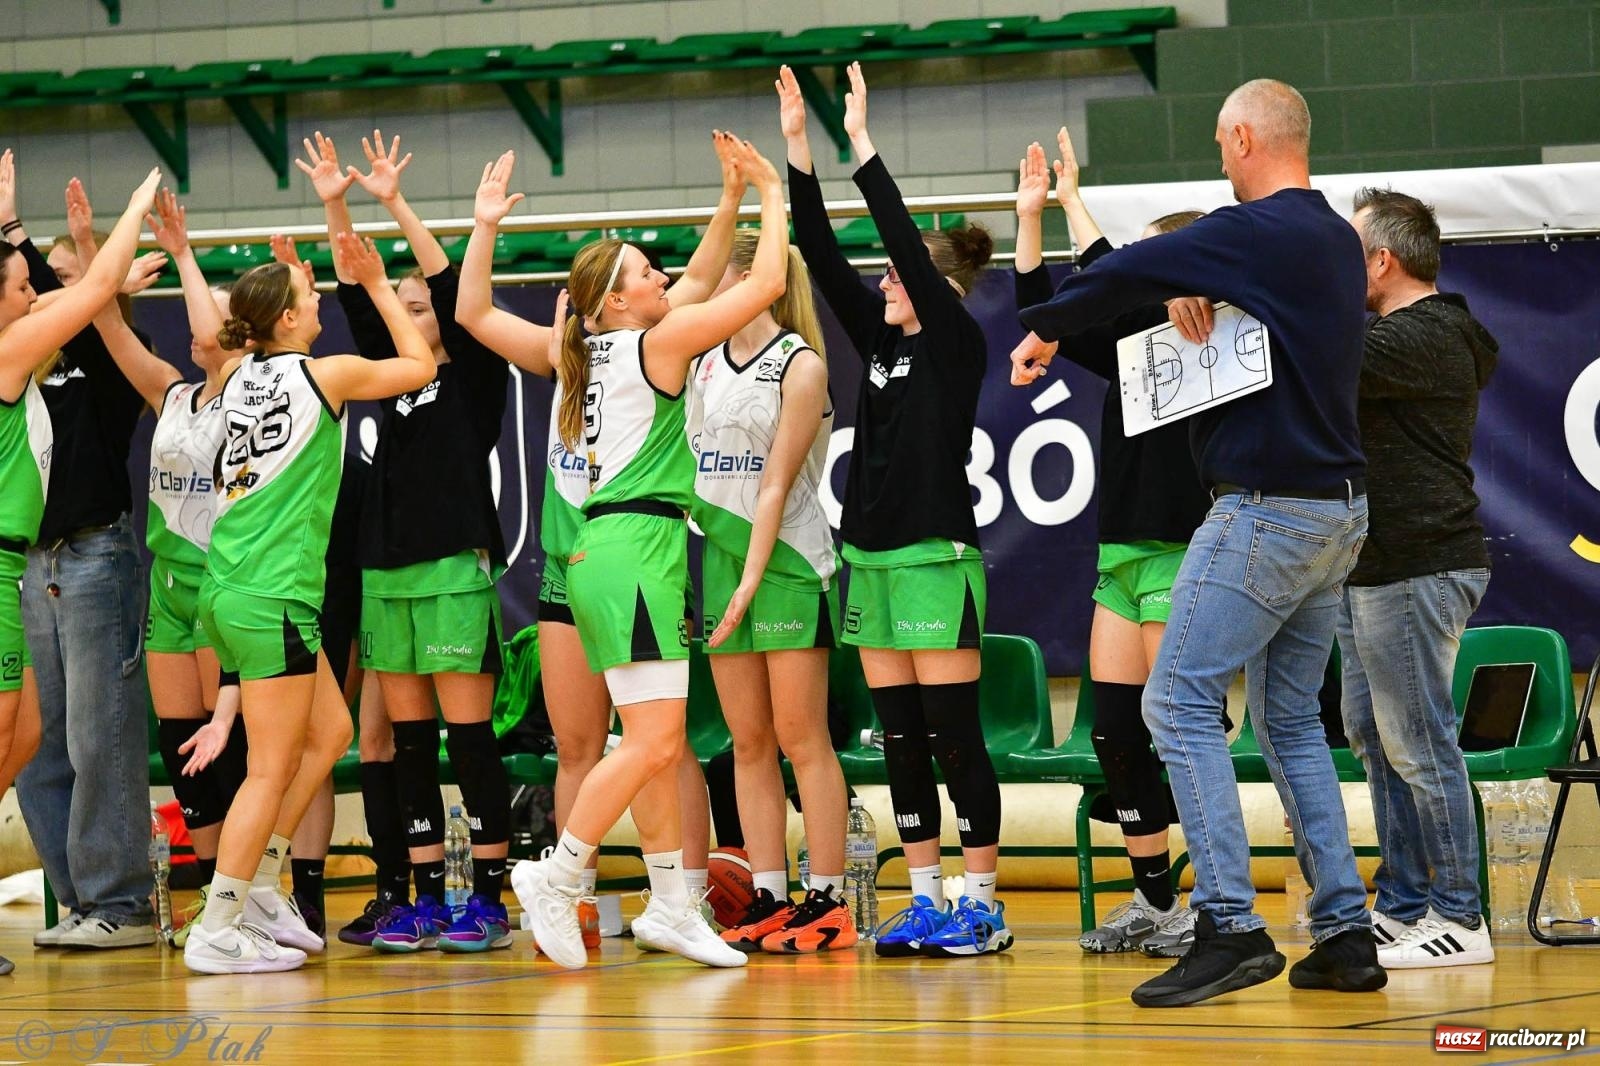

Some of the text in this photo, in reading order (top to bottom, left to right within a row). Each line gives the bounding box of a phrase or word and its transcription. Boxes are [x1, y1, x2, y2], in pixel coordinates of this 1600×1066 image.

[698, 449, 765, 473] Clavis
[160, 471, 212, 493] Clavis
[3, 652, 23, 681] 2
[902, 812, 921, 828] NBA
[1121, 808, 1142, 822] NBA
